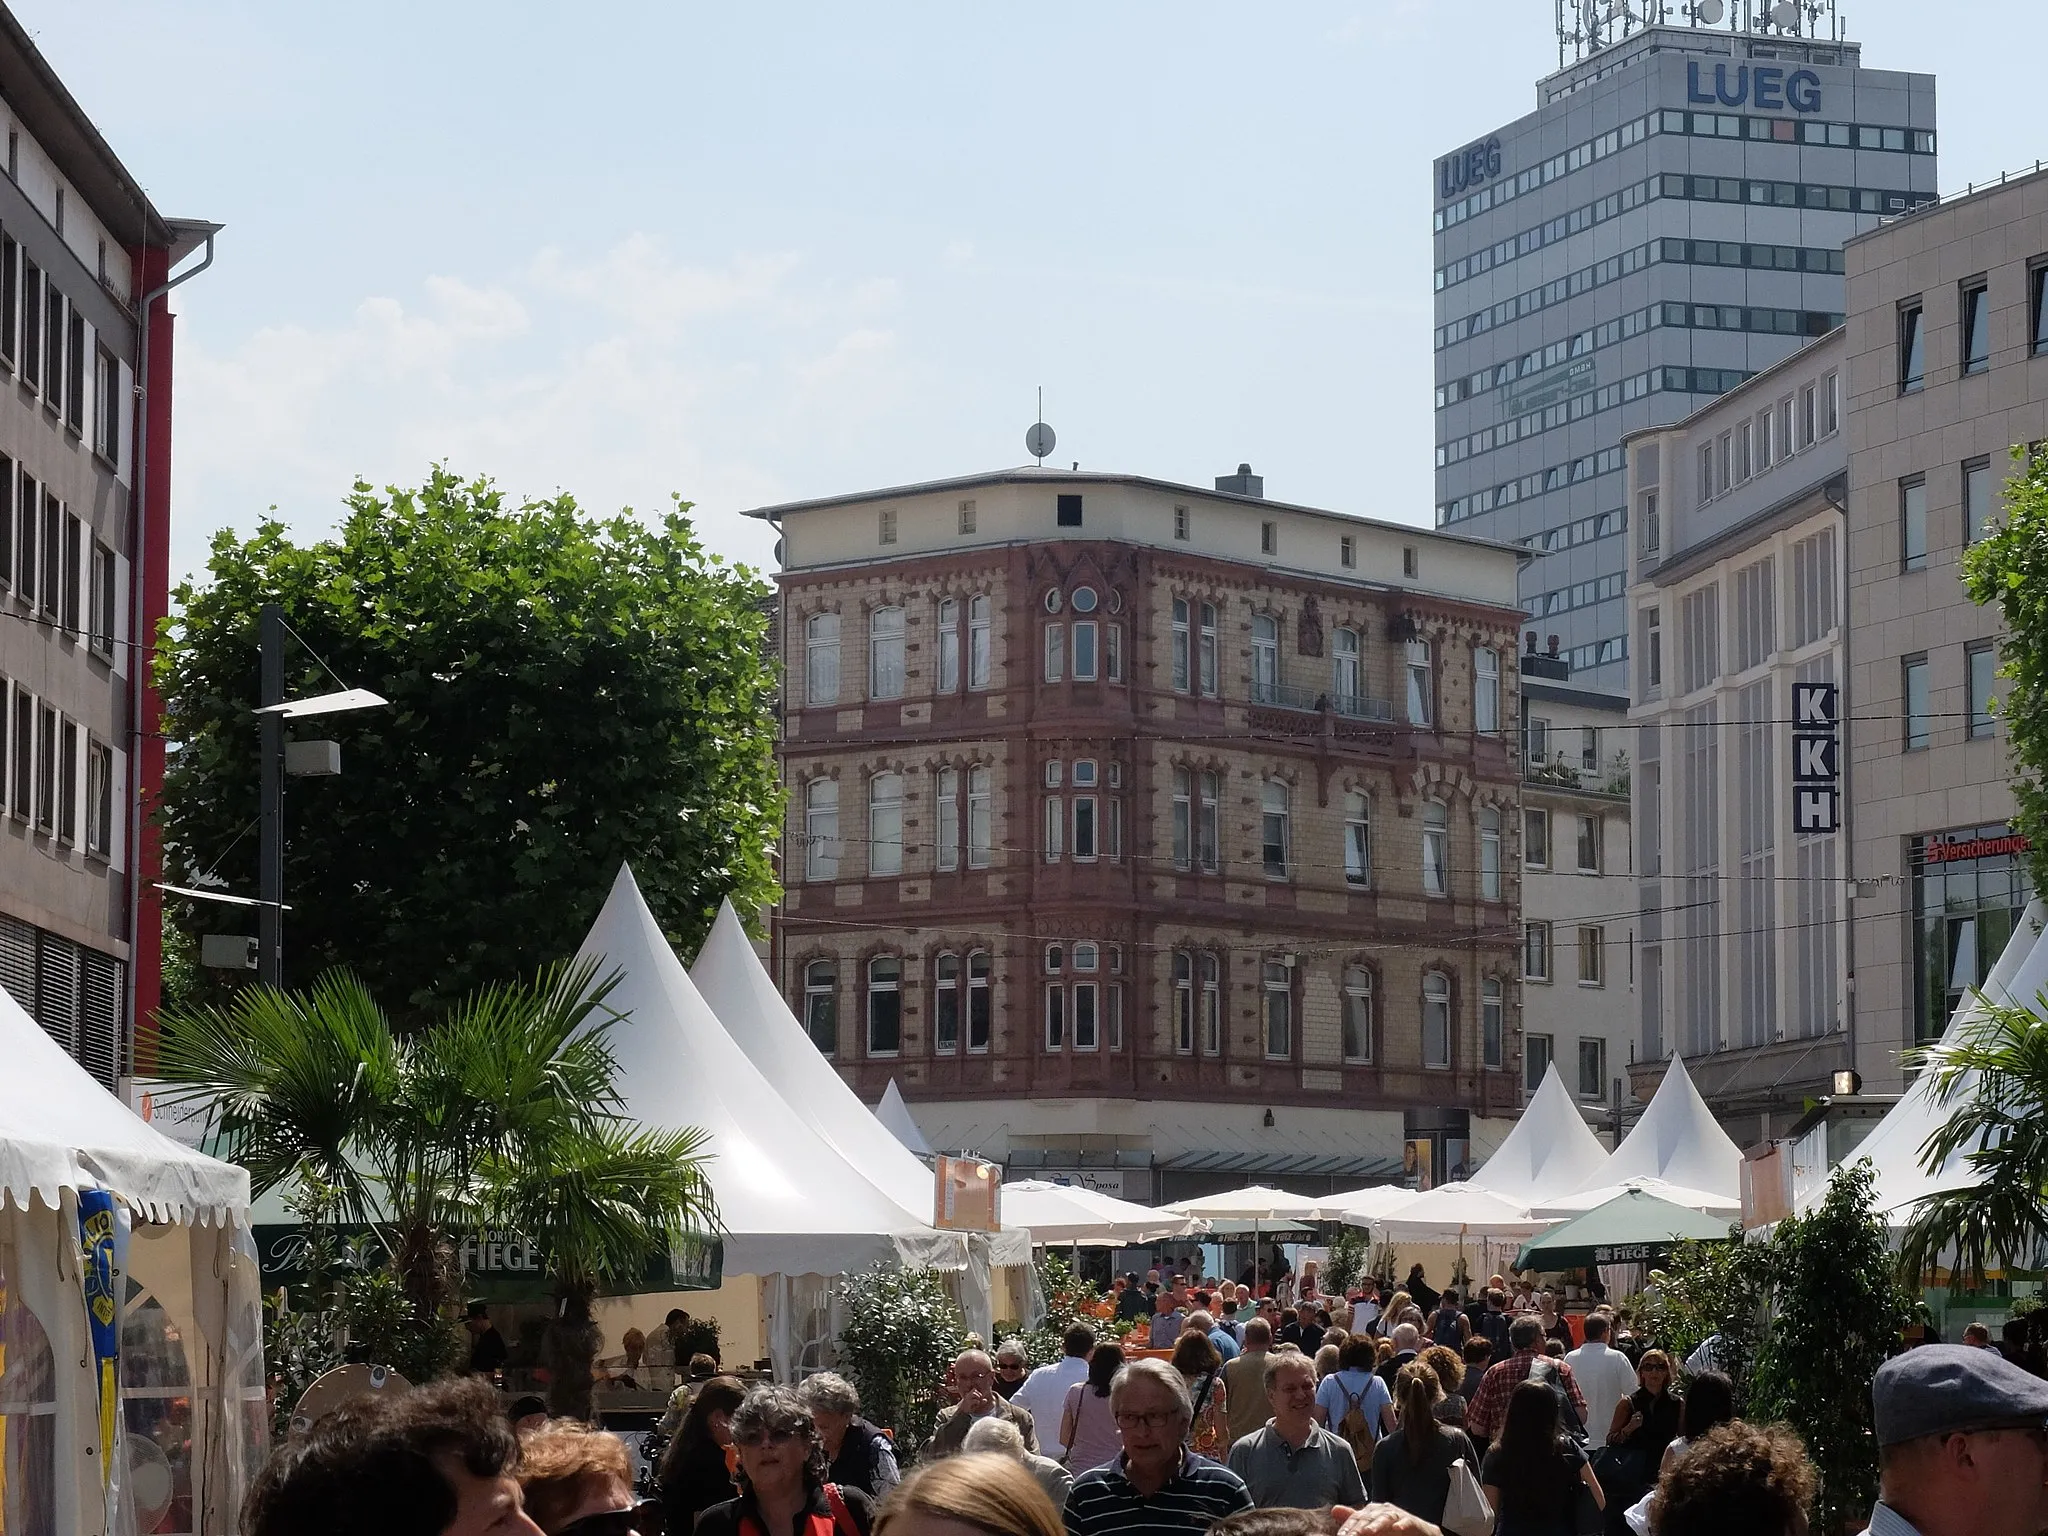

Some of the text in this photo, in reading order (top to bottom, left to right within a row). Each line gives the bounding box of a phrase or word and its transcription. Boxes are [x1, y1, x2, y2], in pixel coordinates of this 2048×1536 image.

[1687, 61, 1821, 112] LUEG
[1441, 136, 1501, 199] LUEG
[1799, 688, 1831, 828] KKH
[459, 1234, 539, 1271] FIEGE
[1613, 1245, 1650, 1260] FIEGE
